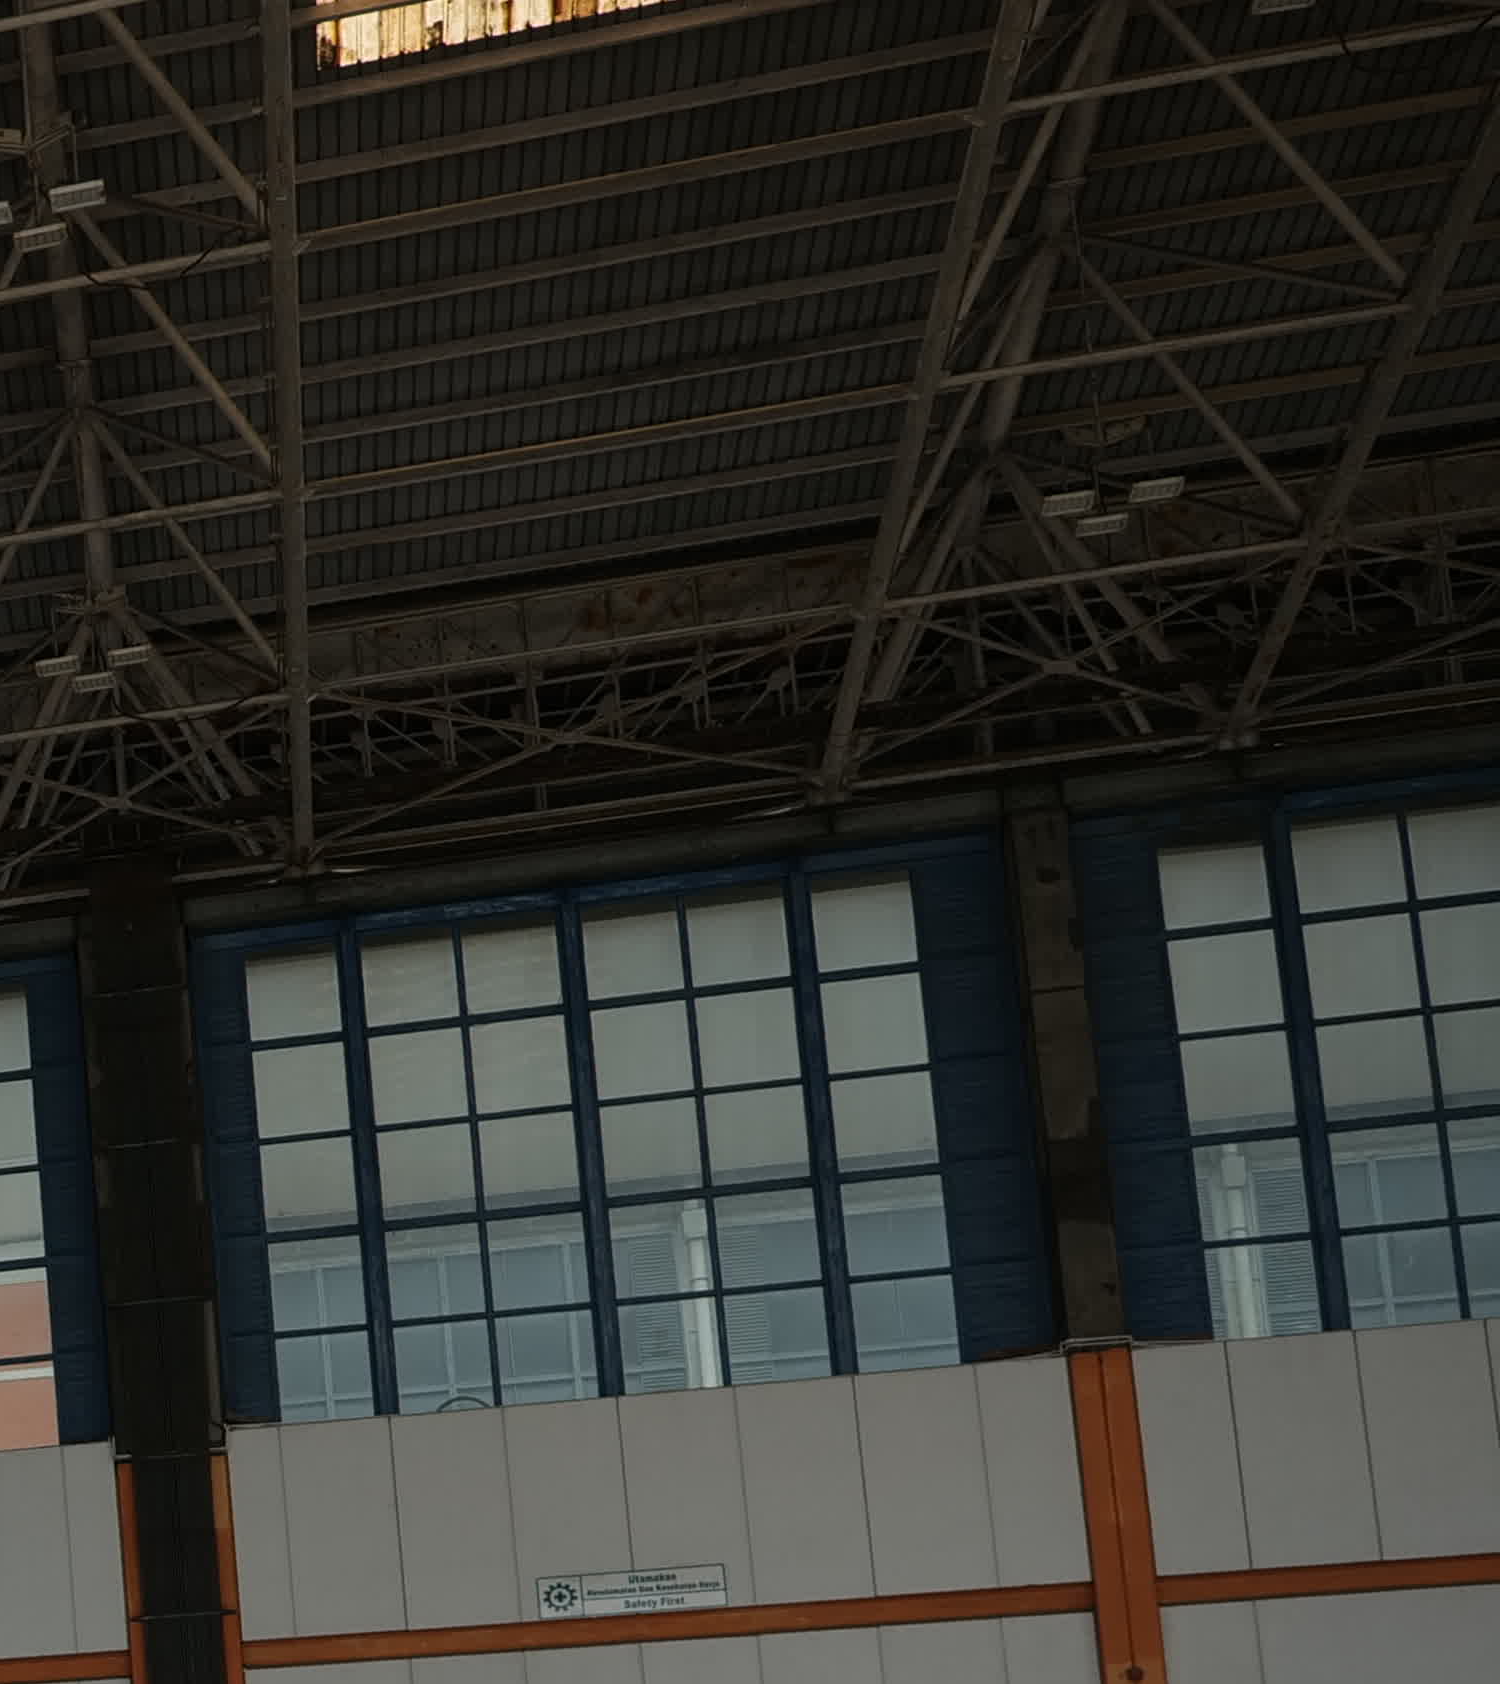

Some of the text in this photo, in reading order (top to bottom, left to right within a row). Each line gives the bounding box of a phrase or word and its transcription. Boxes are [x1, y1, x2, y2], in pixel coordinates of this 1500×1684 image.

[628, 1572, 676, 1584] Utamakan
[624, 1596, 684, 1609] Safety First
